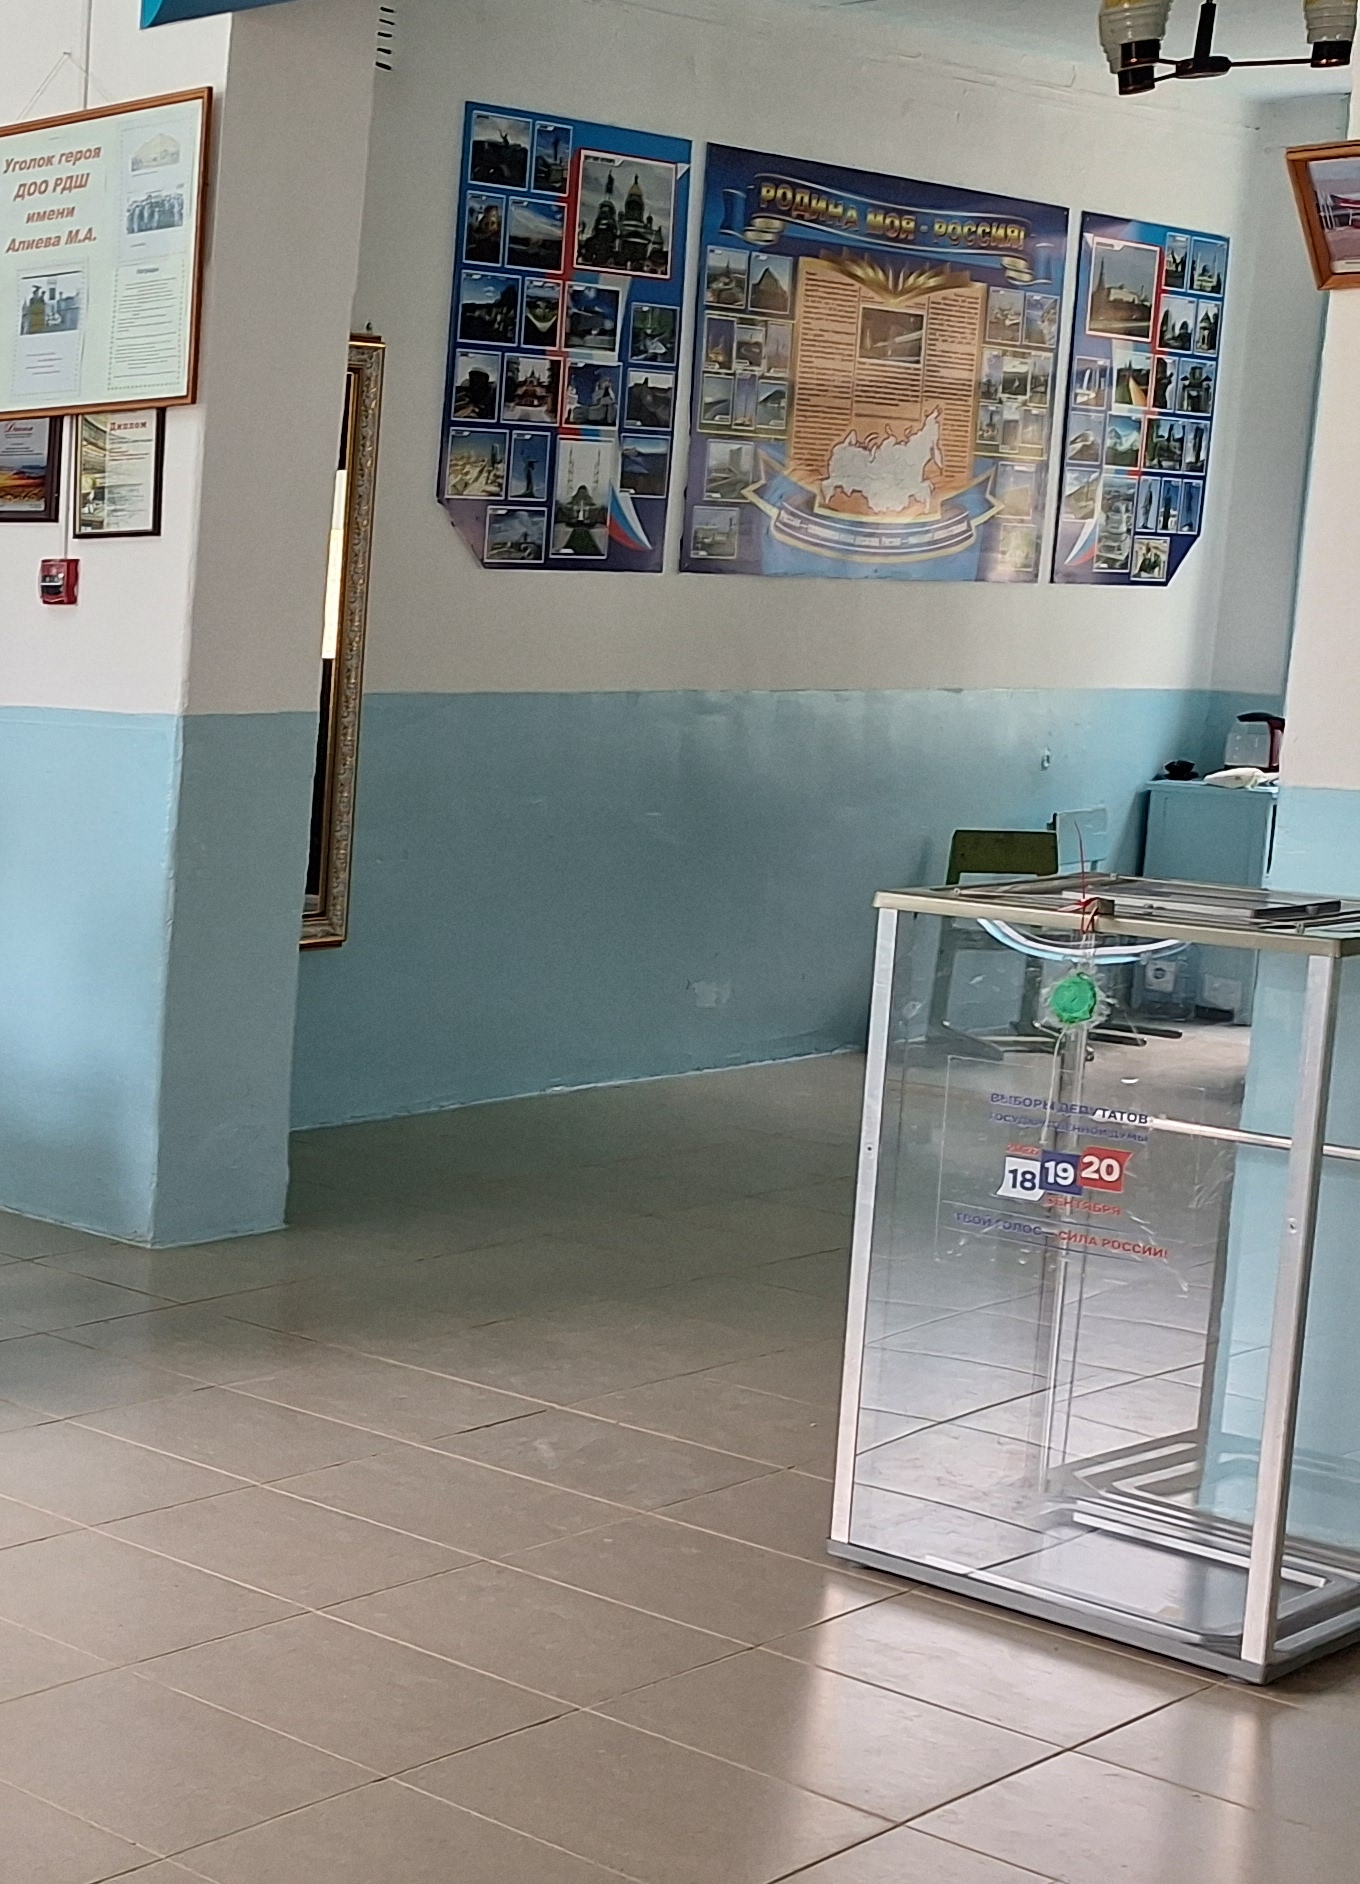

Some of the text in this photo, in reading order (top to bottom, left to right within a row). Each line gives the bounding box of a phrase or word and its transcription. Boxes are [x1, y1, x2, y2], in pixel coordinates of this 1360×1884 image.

[2, 147, 102, 175] Уголок героя
[13, 172, 90, 201] ДОО РДШ
[25, 205, 75, 224] имени
[759, 182, 860, 231] РОДИНА
[866, 210, 917, 240] МОЯ
[5, 227, 97, 254] Алиева М.А.
[110, 421, 147, 432] Диплом
[1008, 1155, 1120, 1191] 18 19 20
[1058, 1230, 1097, 1247] СИЛА
[1102, 1238, 1169, 1260] РОССИИ!
